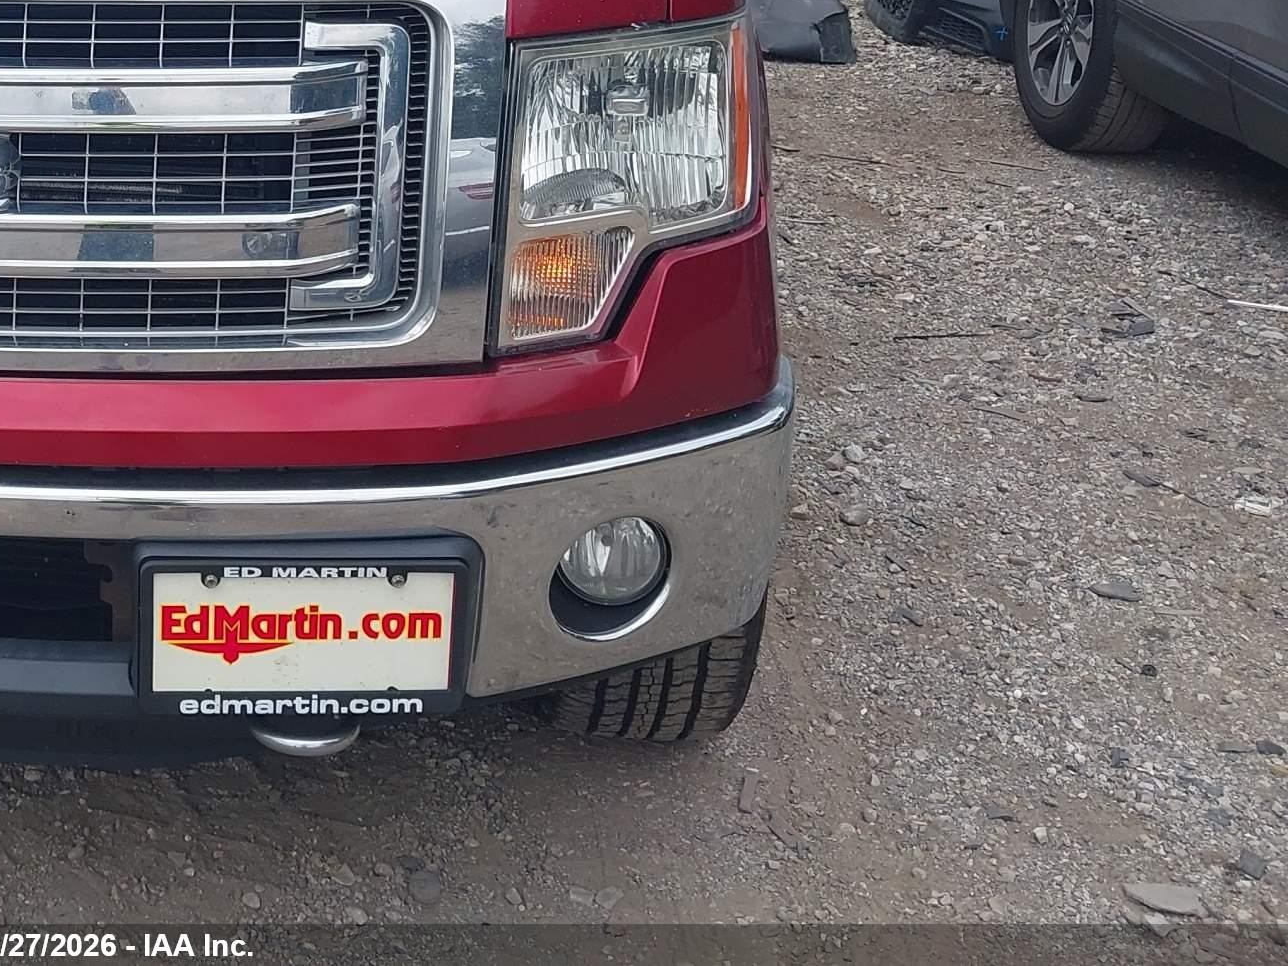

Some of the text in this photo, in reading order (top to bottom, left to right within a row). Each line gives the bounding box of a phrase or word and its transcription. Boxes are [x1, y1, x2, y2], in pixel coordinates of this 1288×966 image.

[223, 567, 387, 578] ED MARTIN
[161, 604, 443, 646] EdMartin.com
[179, 694, 423, 714] edmartin.com
